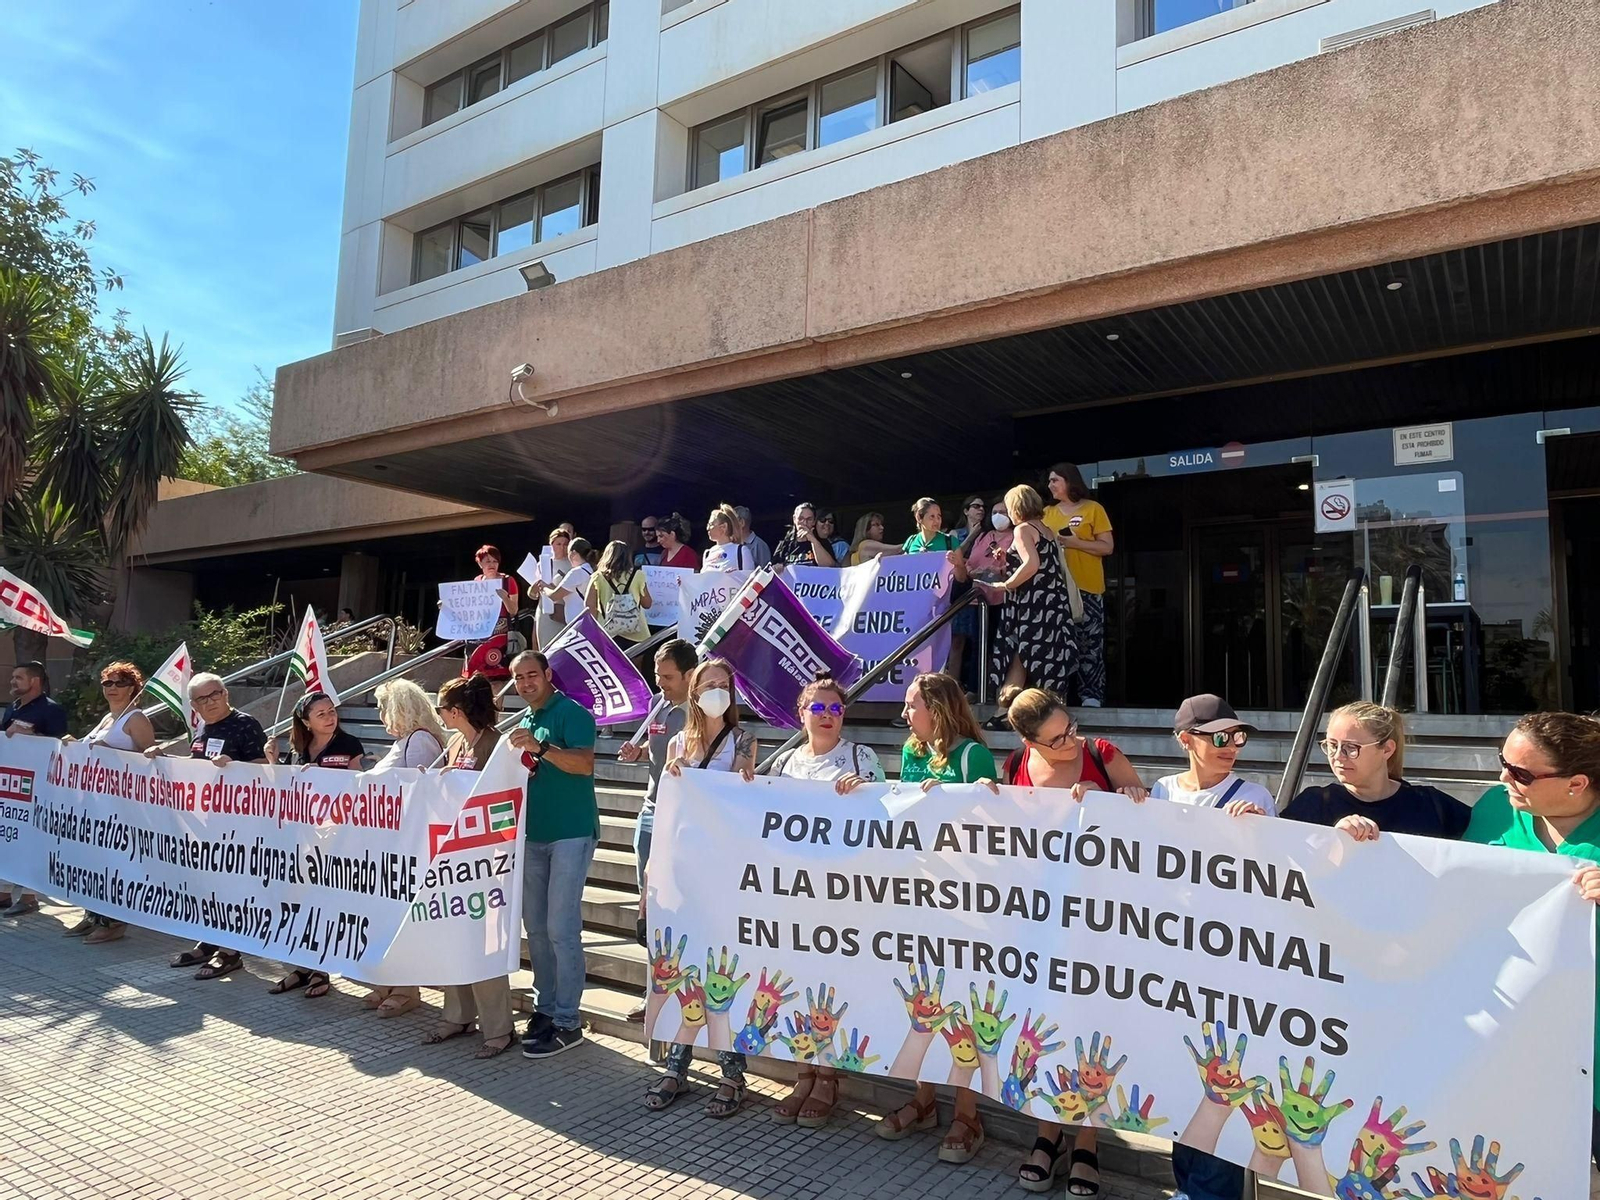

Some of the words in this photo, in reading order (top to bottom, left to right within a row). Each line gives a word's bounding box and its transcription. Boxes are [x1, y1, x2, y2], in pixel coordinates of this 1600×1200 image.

[1399, 433, 1408, 441] EN
[1408, 431, 1423, 440] ESTE
[1424, 429, 1446, 438] CENTRO
[1401, 442, 1415, 450] ESTA
[1416, 438, 1445, 448] PROHIBIDO
[1169, 452, 1214, 468] SALIDA
[1414, 450, 1433, 458] FUMAR
[451, 582, 489, 595] FALTAN
[875, 570, 941, 594] PÚBLICA
[450, 608, 491, 622] SOBRAN
[450, 621, 491, 635] EXCUSAS
[574, 645, 627, 710] CCOO
[778, 656, 809, 688] Málag
[68, 762, 79, 788] en
[81, 757, 120, 796] defensa
[121, 763, 133, 800] de
[134, 772, 147, 803] un
[149, 768, 196, 813] sistema
[200, 774, 277, 819] educativo
[278, 775, 331, 829] público
[351, 783, 403, 831] calidad
[49, 802, 78, 845] bajada
[79, 808, 91, 845] de
[93, 813, 129, 851] ratios
[129, 825, 137, 861] y
[138, 828, 154, 863] por
[156, 832, 178, 865] una
[179, 830, 246, 875] atención
[250, 836, 286, 888] digna
[288, 843, 305, 885] al
[305, 845, 377, 896] alumnado
[380, 851, 417, 903] NEAE
[761, 811, 832, 846] POR
[842, 818, 923, 851] UNA
[932, 822, 1141, 874] ATENCIÓN
[1156, 844, 1316, 909] DIGNA
[49, 850, 65, 888] Más
[66, 862, 109, 902] personal
[111, 868, 124, 906] de
[126, 875, 200, 925] orientación
[201, 891, 272, 949] educativa,
[273, 901, 301, 956] PT,
[298, 906, 321, 952] AL
[319, 919, 335, 965] y
[333, 911, 370, 962] PTIS
[411, 886, 507, 923] málaga
[739, 863, 763, 893] A
[772, 866, 816, 899] LA
[826, 872, 1051, 922] DIVERSIDAD
[1061, 894, 1345, 984] FUNCIONAL
[738, 915, 780, 949] EN
[792, 922, 860, 957] LOS
[871, 930, 1039, 985] CENTROS
[1048, 957, 1349, 1056] EDUCATIVOS
